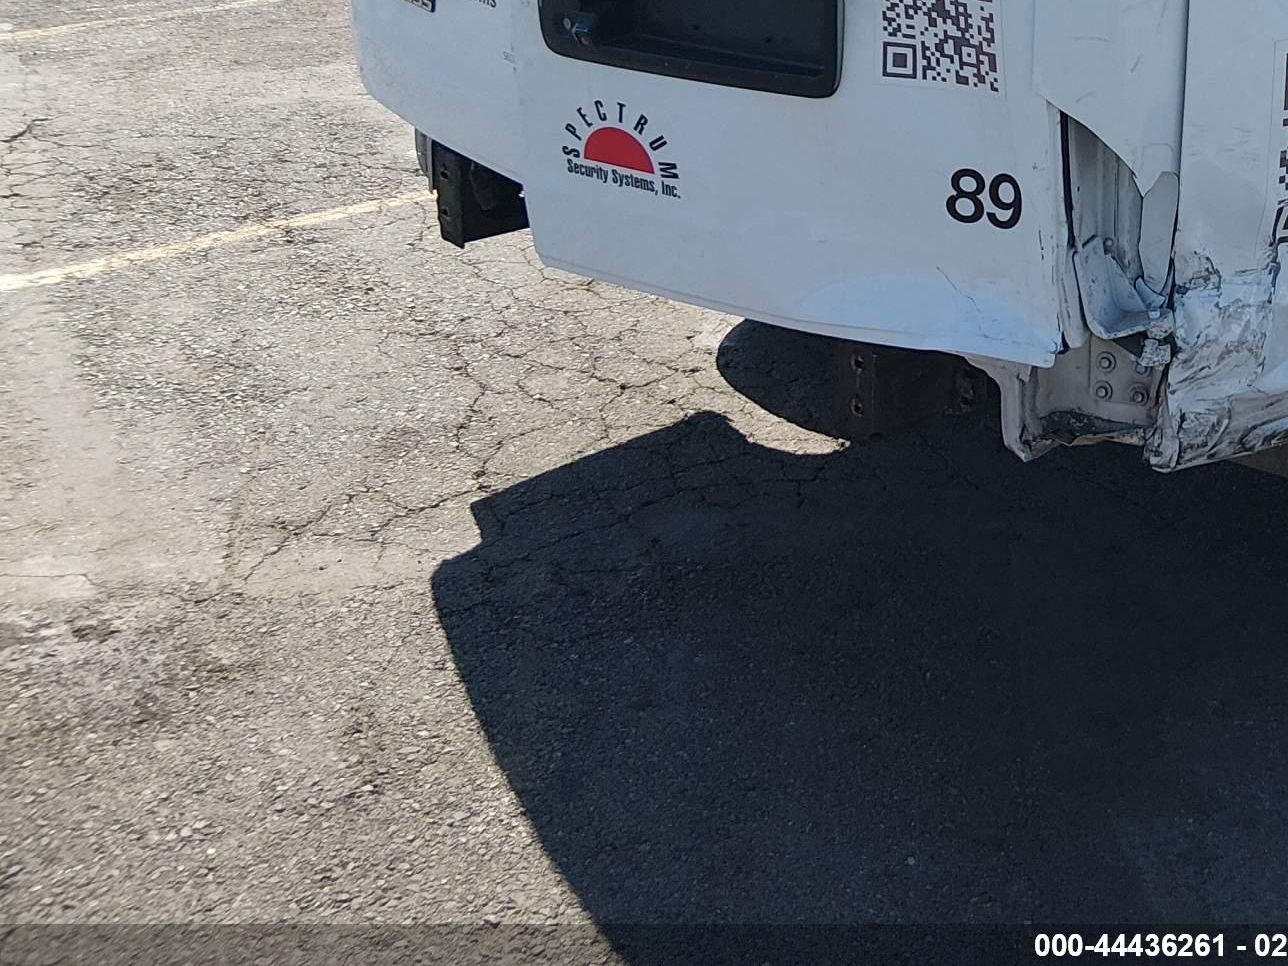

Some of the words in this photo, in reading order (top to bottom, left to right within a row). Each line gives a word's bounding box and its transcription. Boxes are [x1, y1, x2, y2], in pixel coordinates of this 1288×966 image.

[562, 99, 680, 179] SPECTRUM
[567, 158, 608, 184] Security
[611, 169, 658, 196] Systems,
[660, 180, 681, 199] Inc.
[946, 168, 1023, 230] 89
